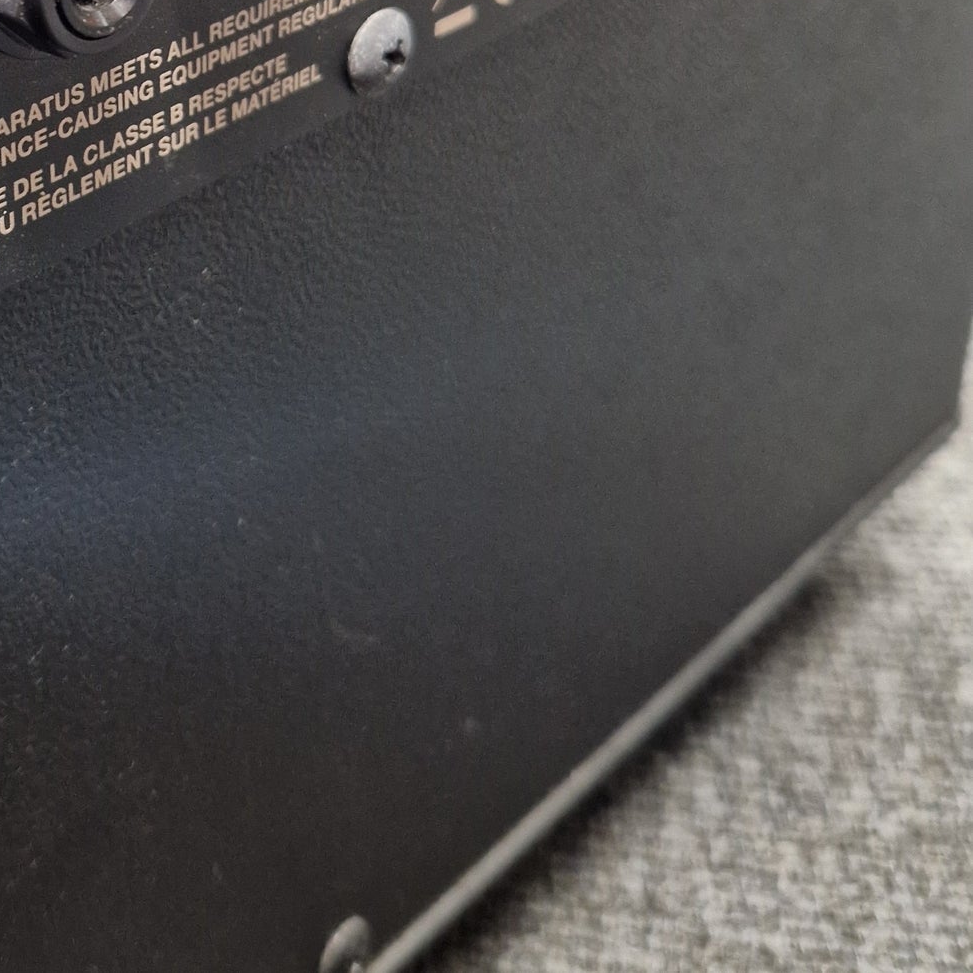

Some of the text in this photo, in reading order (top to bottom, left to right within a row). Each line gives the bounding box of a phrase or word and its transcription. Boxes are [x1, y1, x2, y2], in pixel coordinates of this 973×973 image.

[90, 48, 163, 94] MEETS
[166, 34, 205, 63] ALL
[159, 33, 274, 93] EQUIPMENT
[12, 168, 45, 202] DE
[49, 154, 79, 184] LA
[82, 110, 165, 167] CLASSE
[169, 102, 185, 125] B
[188, 53, 289, 115] RESPECTE
[21, 144, 152, 226] RÈGLEMENT
[157, 126, 200, 157] SUR
[204, 114, 228, 137] LE
[231, 62, 324, 122] MATÉRIEL
